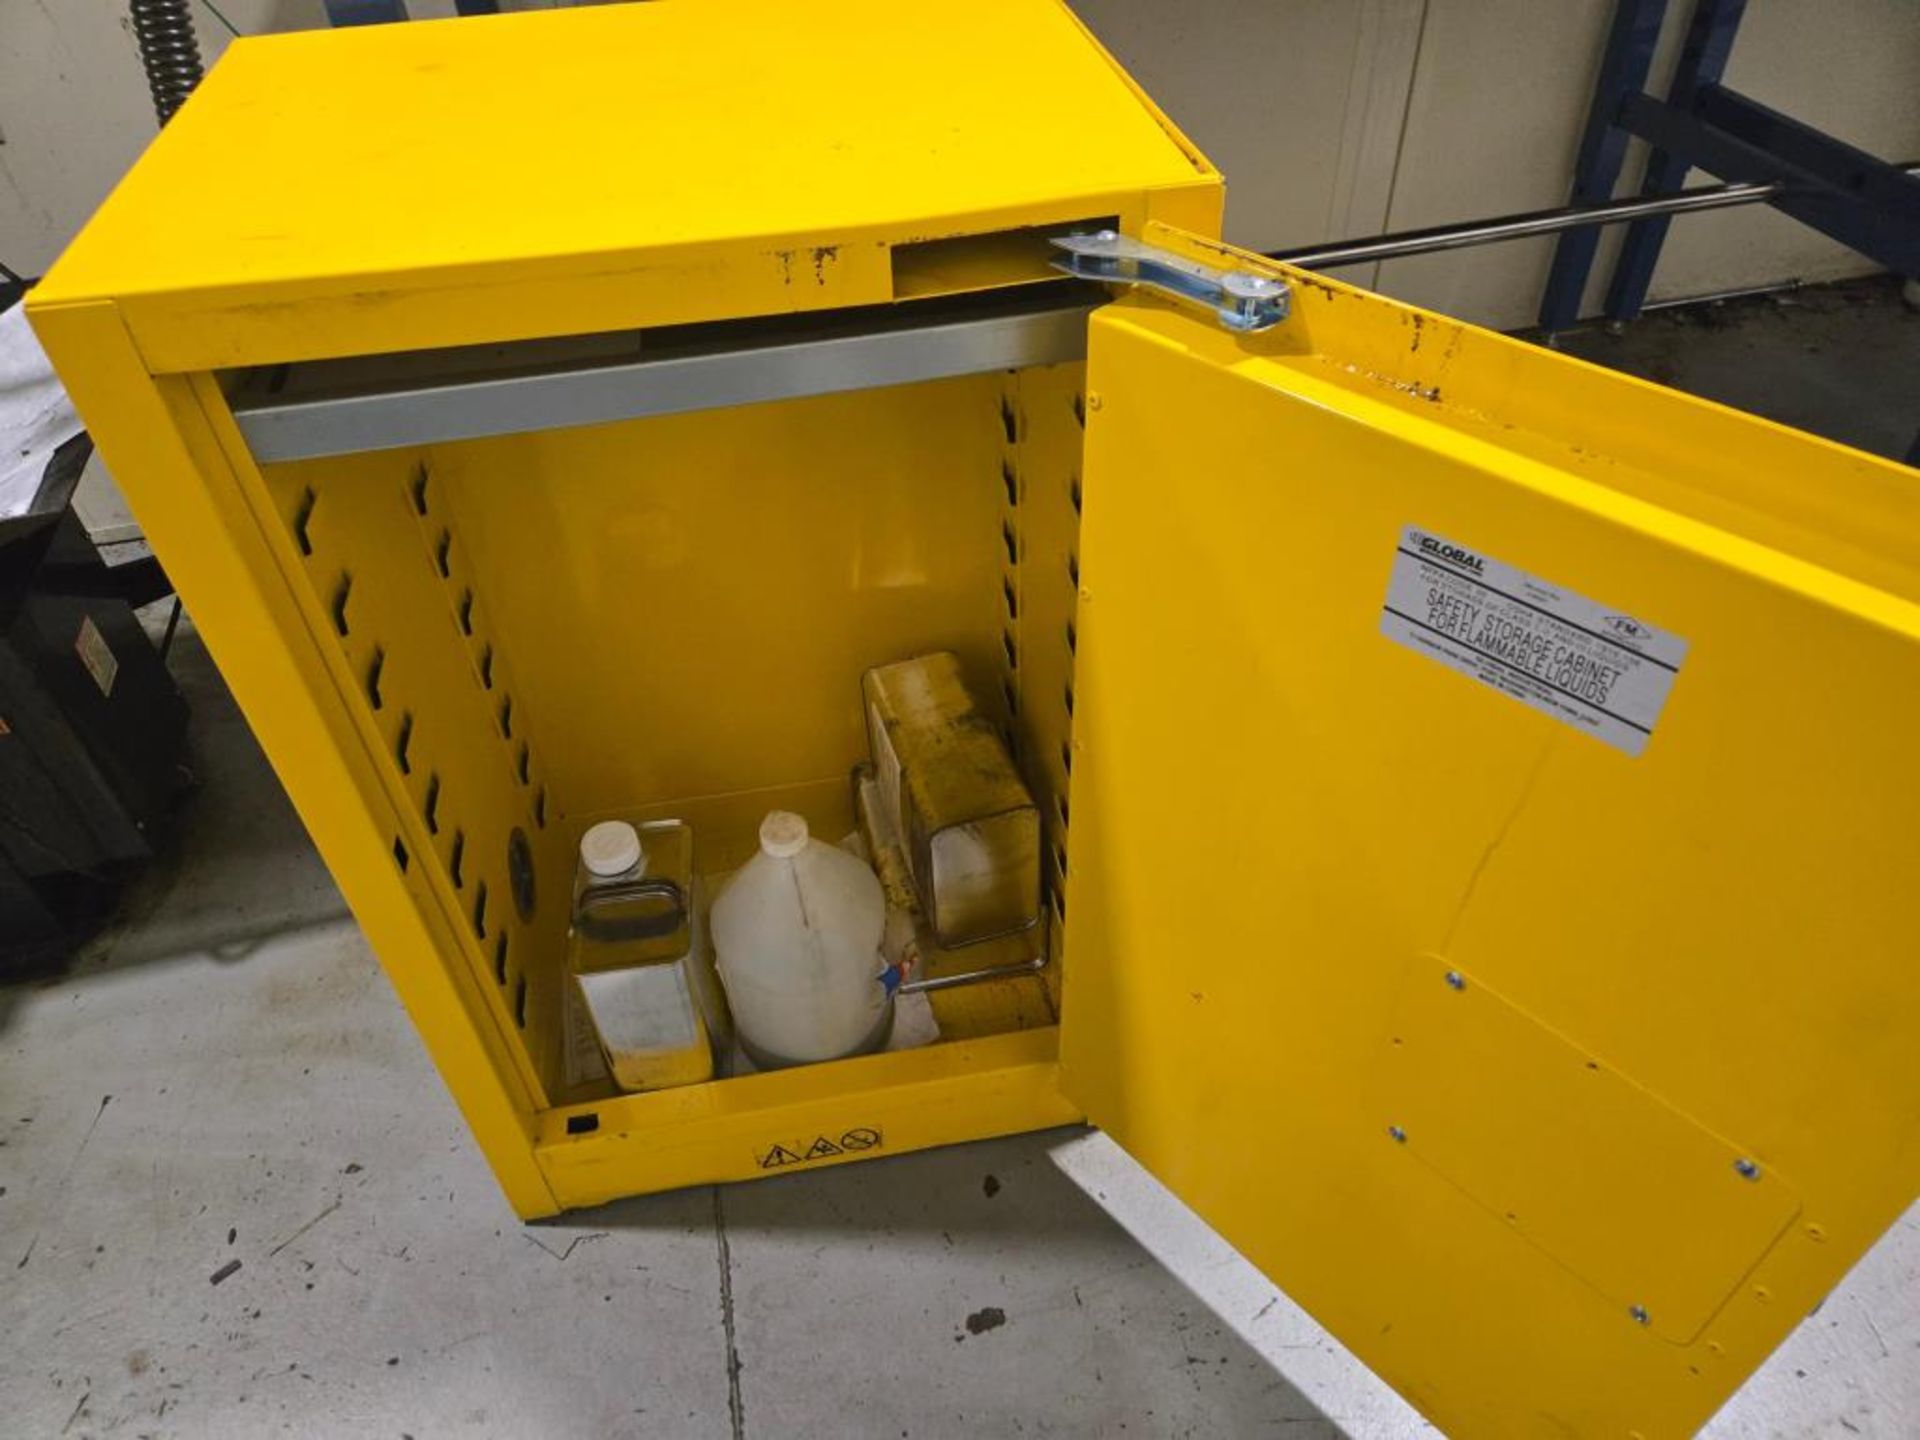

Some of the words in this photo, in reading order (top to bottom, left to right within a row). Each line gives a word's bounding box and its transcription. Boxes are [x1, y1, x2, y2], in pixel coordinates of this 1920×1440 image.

[1420, 537, 1484, 571] GLOBAL
[1424, 586, 1480, 626] SAFETY
[1483, 613, 1554, 659] STORAGE
[1551, 644, 1622, 690] CABINET
[1426, 606, 1458, 635] FOR
[1457, 621, 1545, 676] FLAMMABLE
[1543, 661, 1610, 706] LIQUIDS
[1614, 618, 1639, 637] FM
